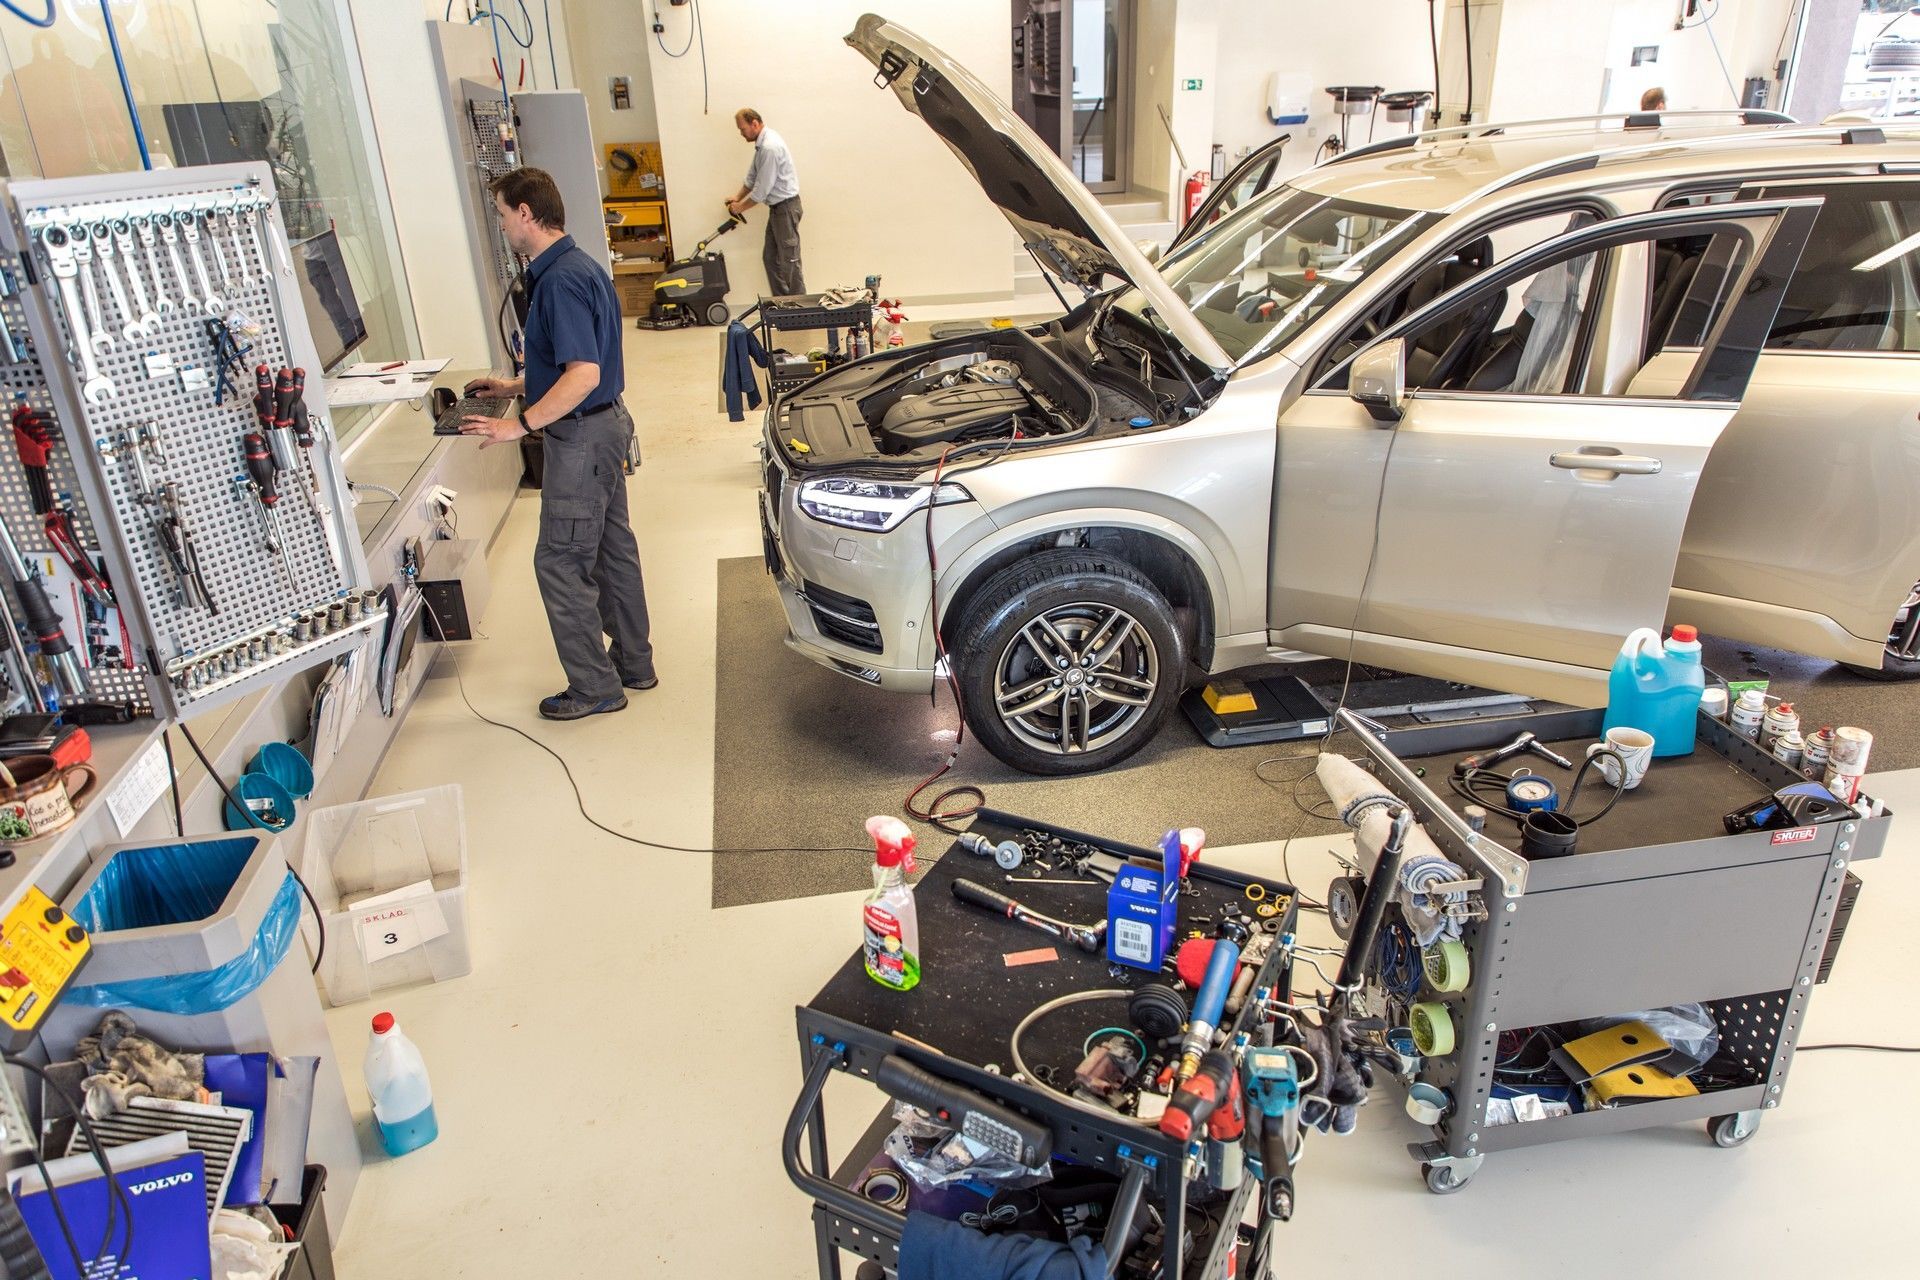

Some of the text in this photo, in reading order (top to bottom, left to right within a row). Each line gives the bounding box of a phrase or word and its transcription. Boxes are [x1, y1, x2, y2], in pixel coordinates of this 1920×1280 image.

[1130, 904, 1157, 914] VOLVO
[365, 910, 403, 923] SKLAD
[384, 933, 398, 944] 3
[129, 1172, 193, 1196] VOLVO
